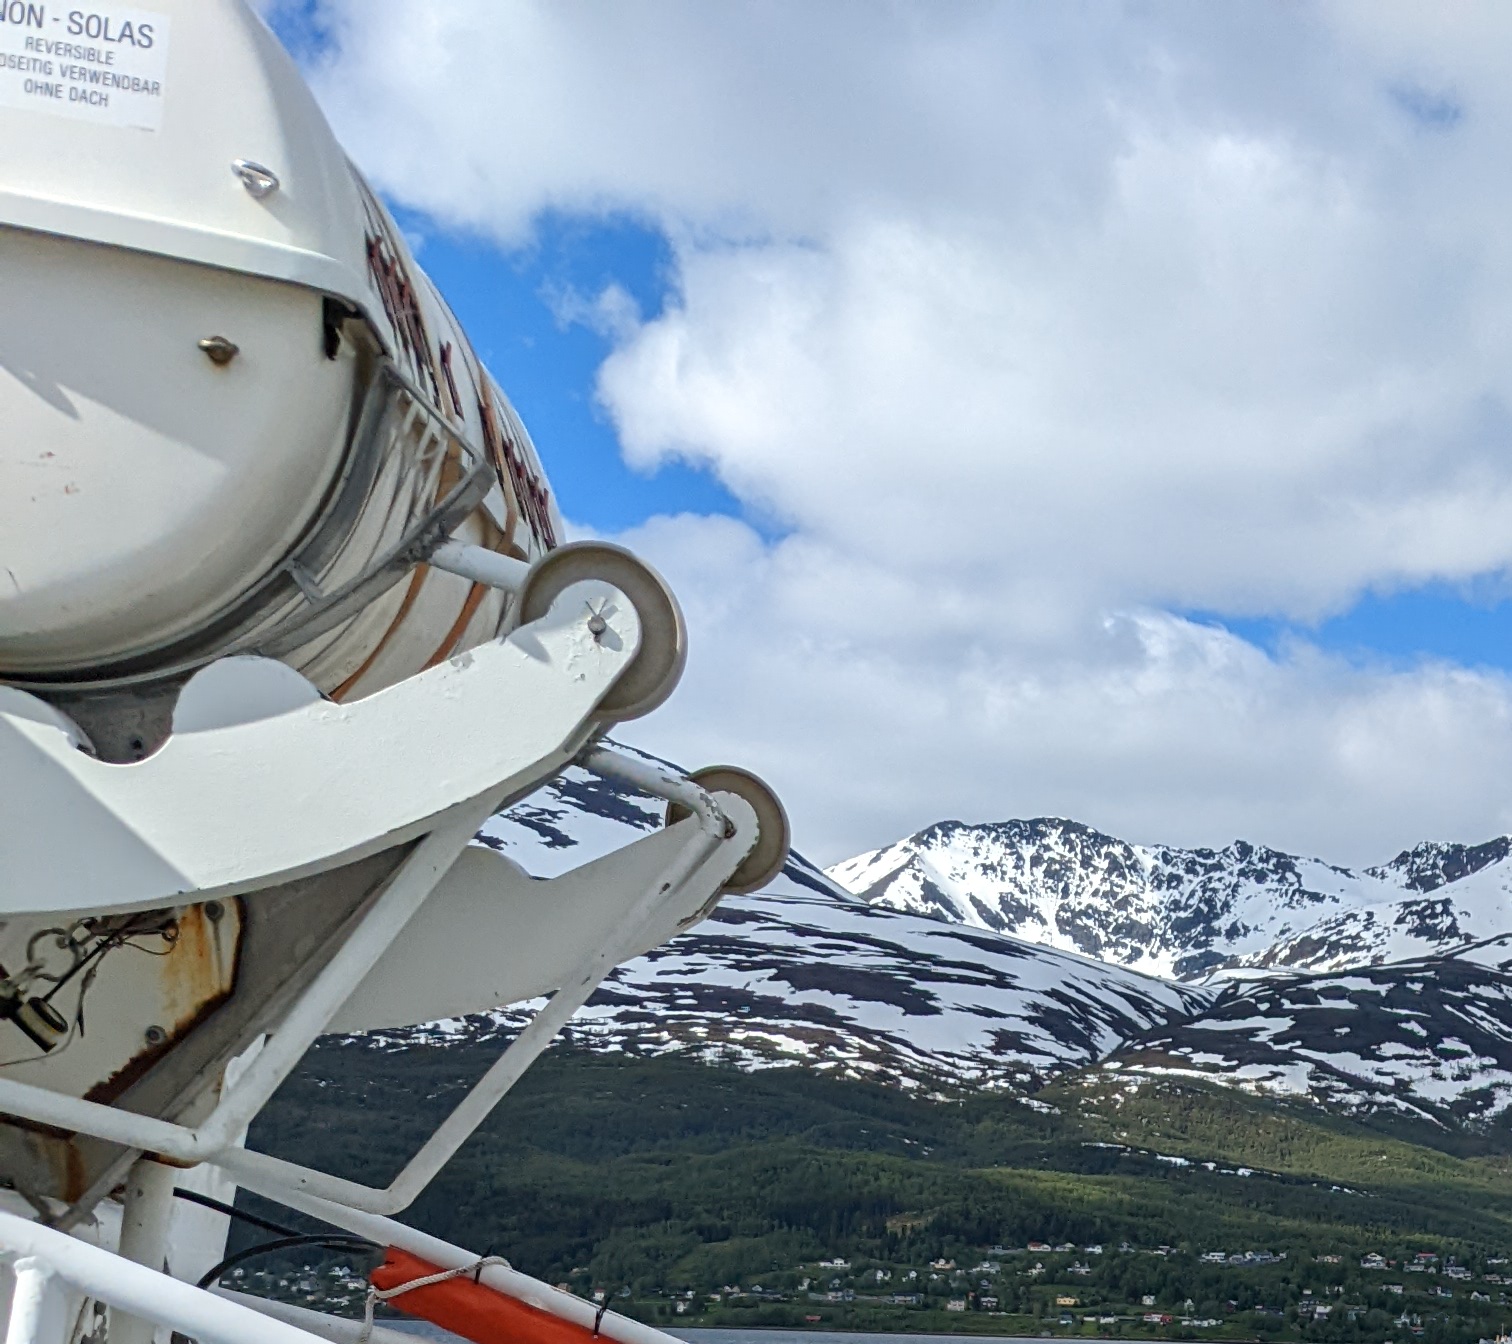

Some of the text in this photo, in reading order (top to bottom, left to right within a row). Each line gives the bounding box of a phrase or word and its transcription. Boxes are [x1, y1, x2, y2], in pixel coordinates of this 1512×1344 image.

[66, 10, 154, 49] SOLAS
[25, 36, 115, 66] REVERSIBLE
[24, 78, 109, 107] OHNE DACH
[59, 63, 161, 96] VERWENDBAR
